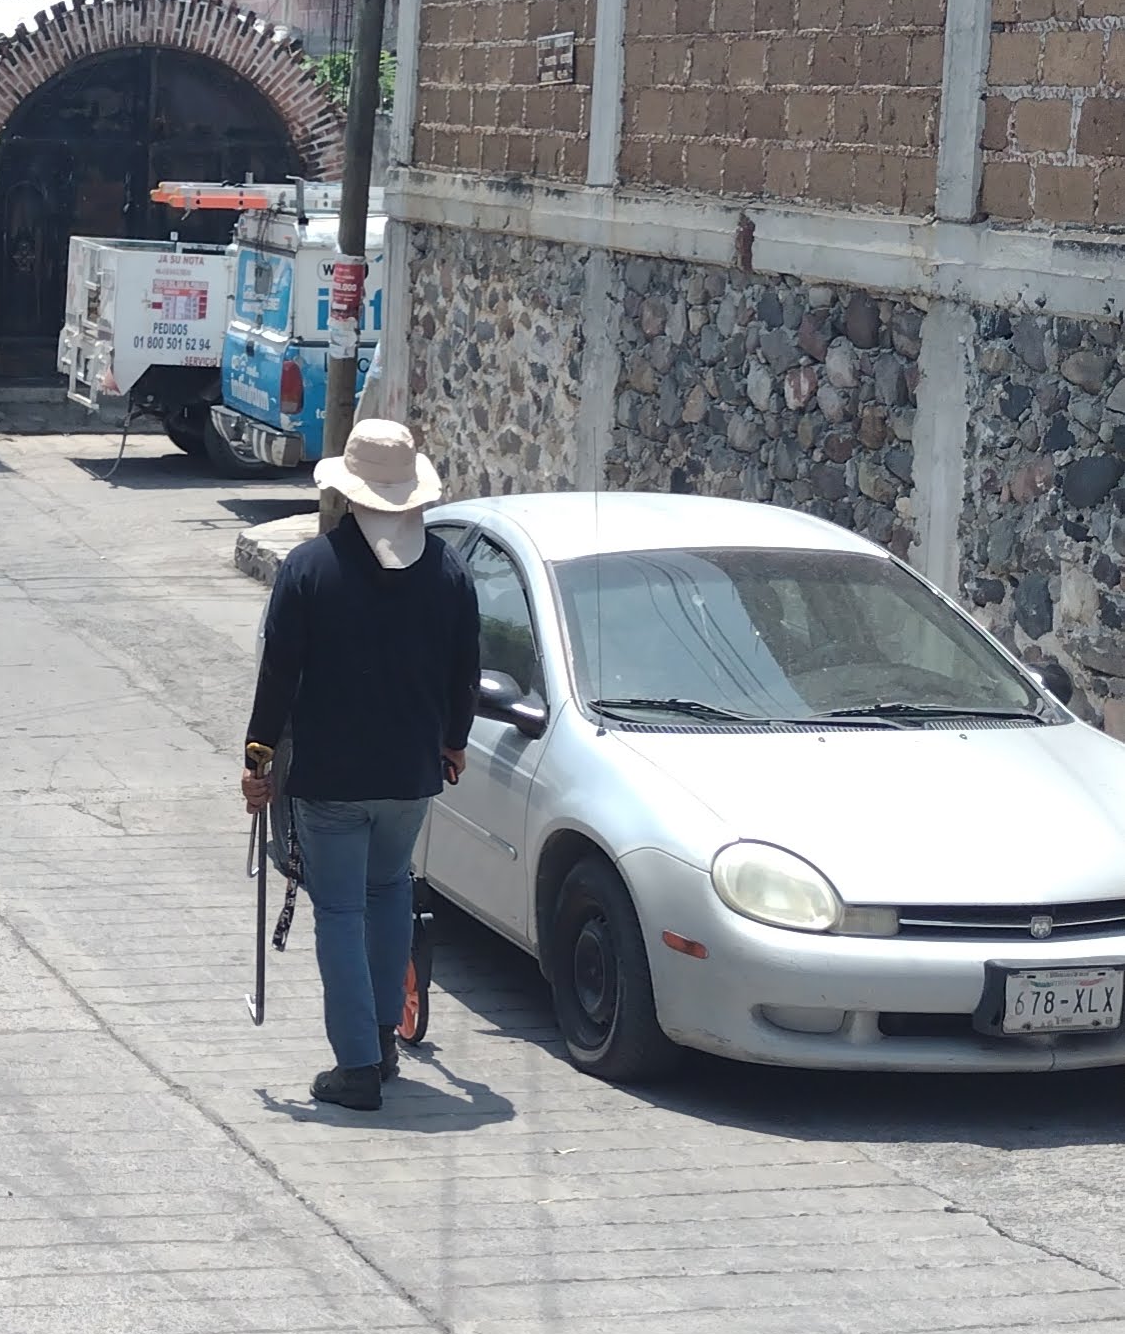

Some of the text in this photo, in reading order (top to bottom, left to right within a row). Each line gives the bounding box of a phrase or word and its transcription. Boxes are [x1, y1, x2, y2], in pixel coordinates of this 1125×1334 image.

[153, 323, 188, 336] PEDIDOS
[133, 336, 211, 351] 01 800 501 62 94
[1014, 986, 1115, 1016] 678-XLX
